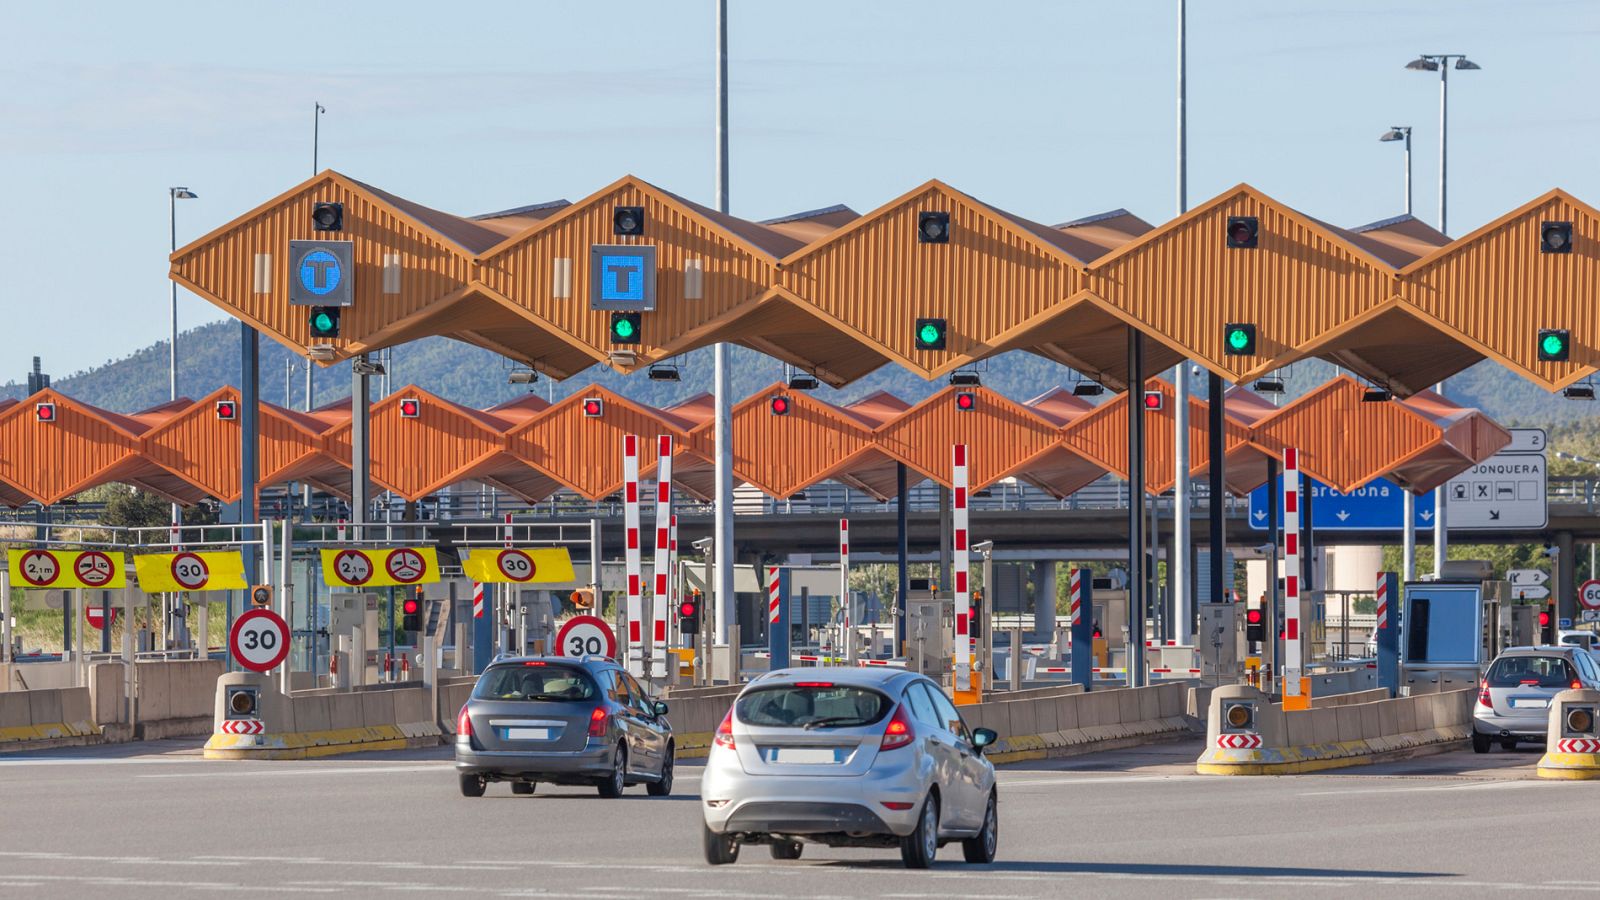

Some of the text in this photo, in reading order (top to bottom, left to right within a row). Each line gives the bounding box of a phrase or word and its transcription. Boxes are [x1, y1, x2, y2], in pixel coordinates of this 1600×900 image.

[305, 260, 335, 288] T
[608, 265, 639, 293] T
[1532, 435, 1540, 445] 2
[1472, 464, 1540, 474] JONQUERA
[179, 564, 202, 577] 30
[505, 559, 528, 571] 30
[1534, 573, 1540, 582] 2
[244, 629, 276, 650] 30
[569, 636, 602, 657] 30
